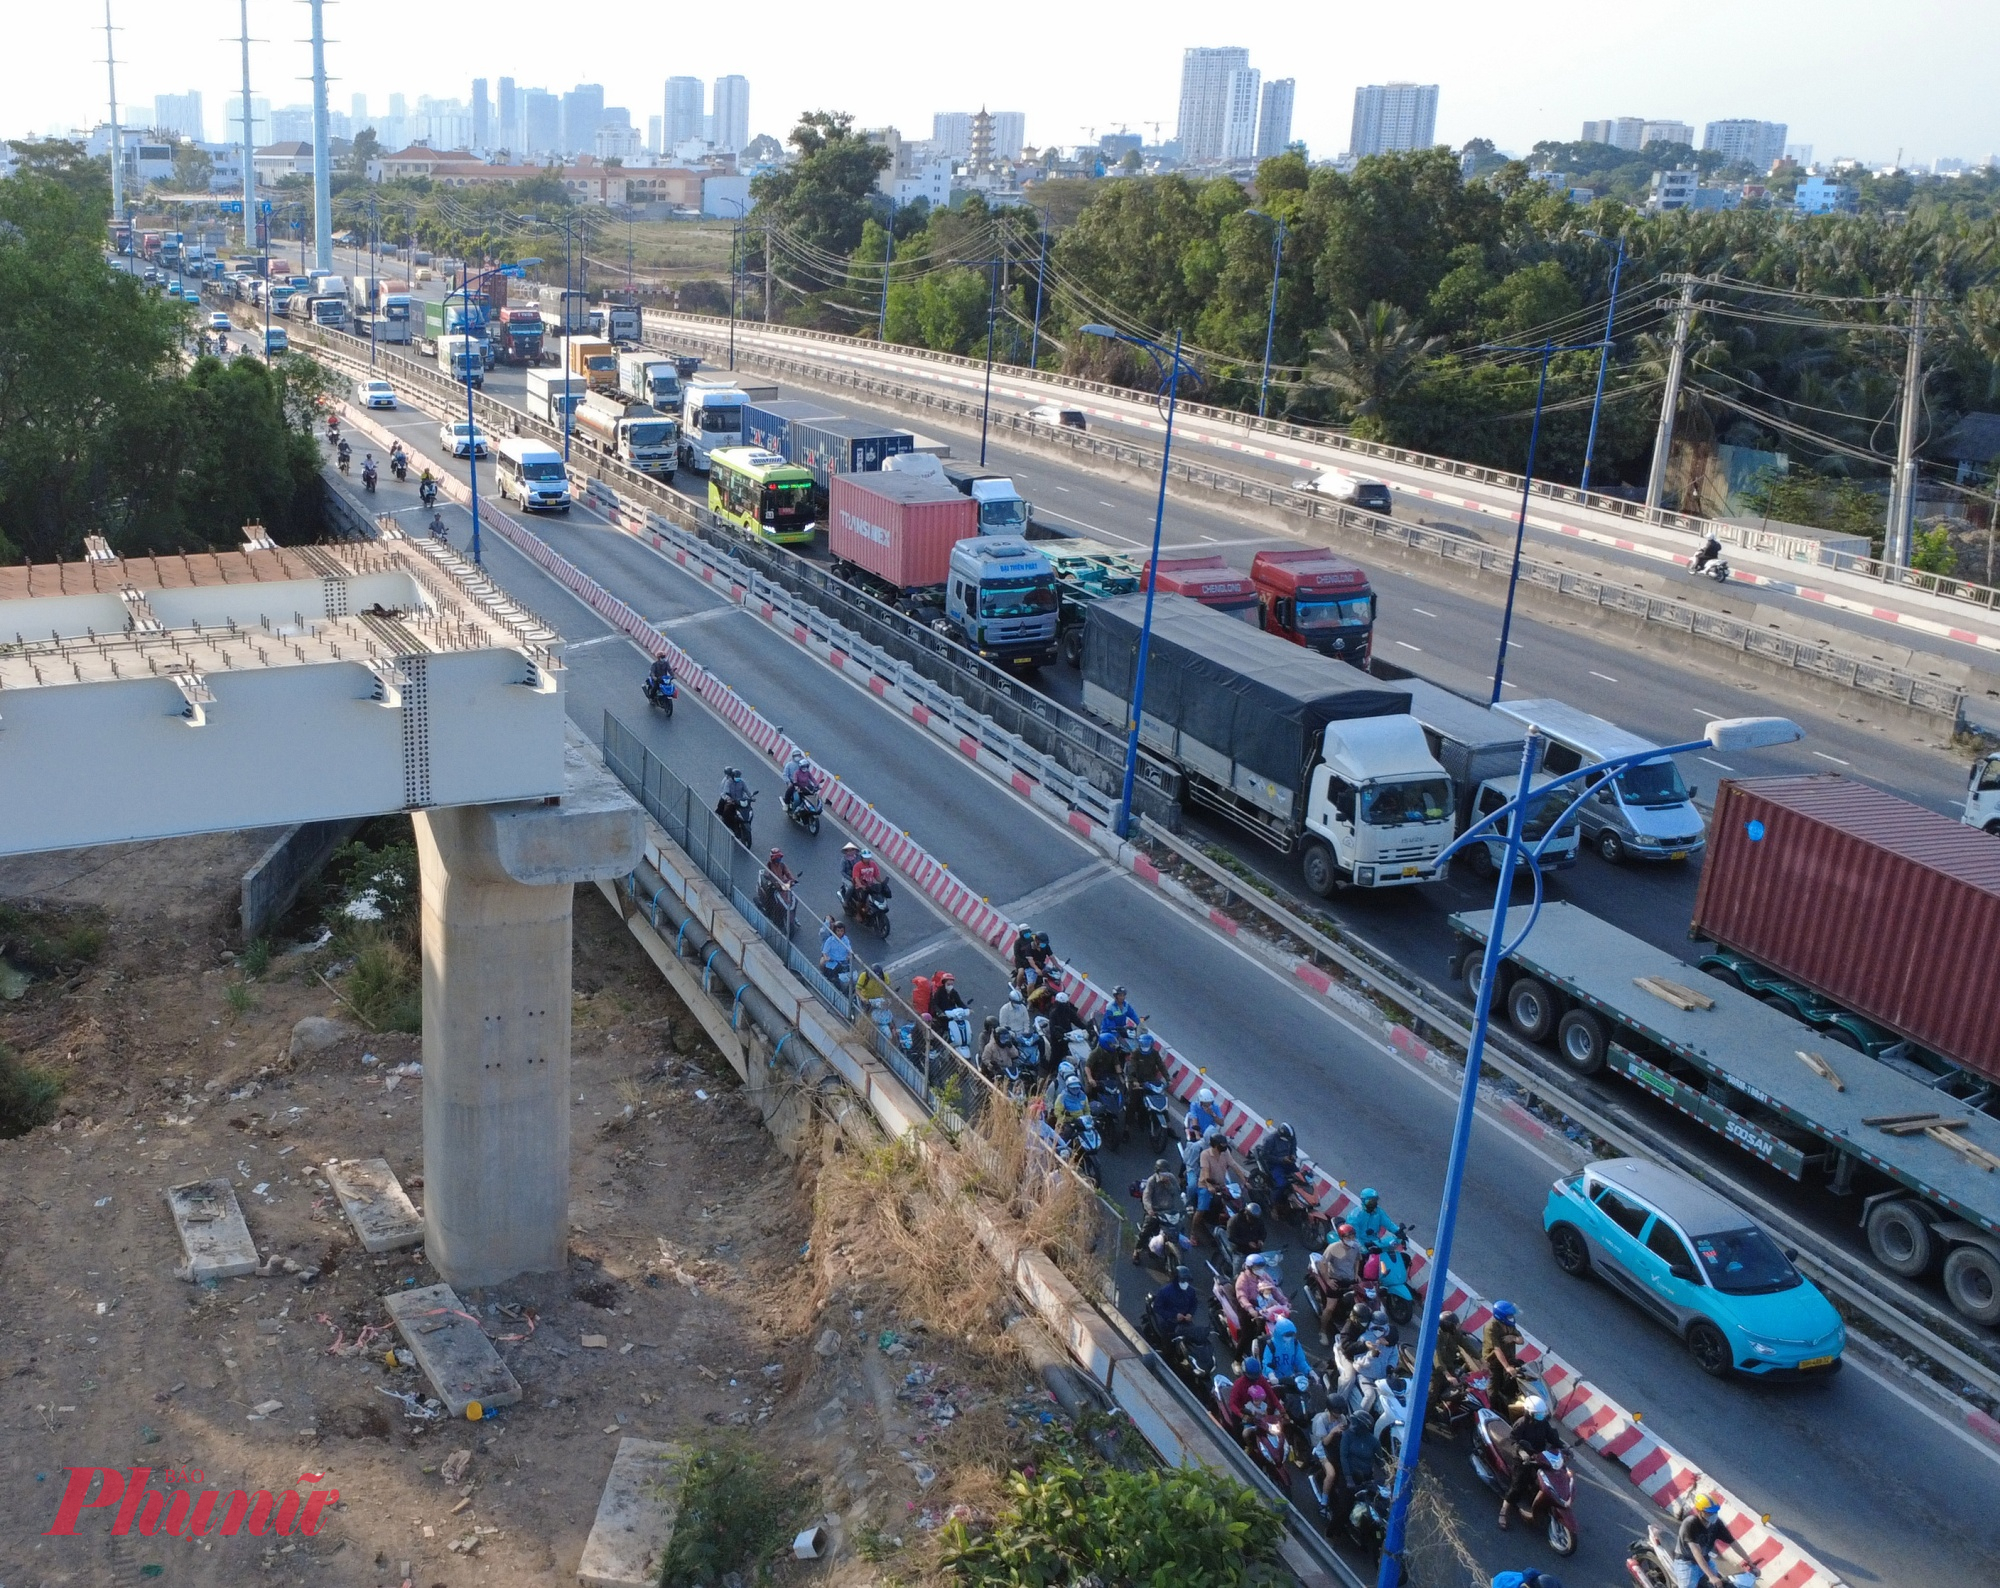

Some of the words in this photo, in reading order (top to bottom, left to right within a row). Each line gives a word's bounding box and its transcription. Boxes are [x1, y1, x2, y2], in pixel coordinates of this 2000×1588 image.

[1316, 574, 1354, 584] CHENGLONG
[1202, 583, 1241, 594] CHENGLONG
[1725, 1120, 1773, 1156] SOOSAN
